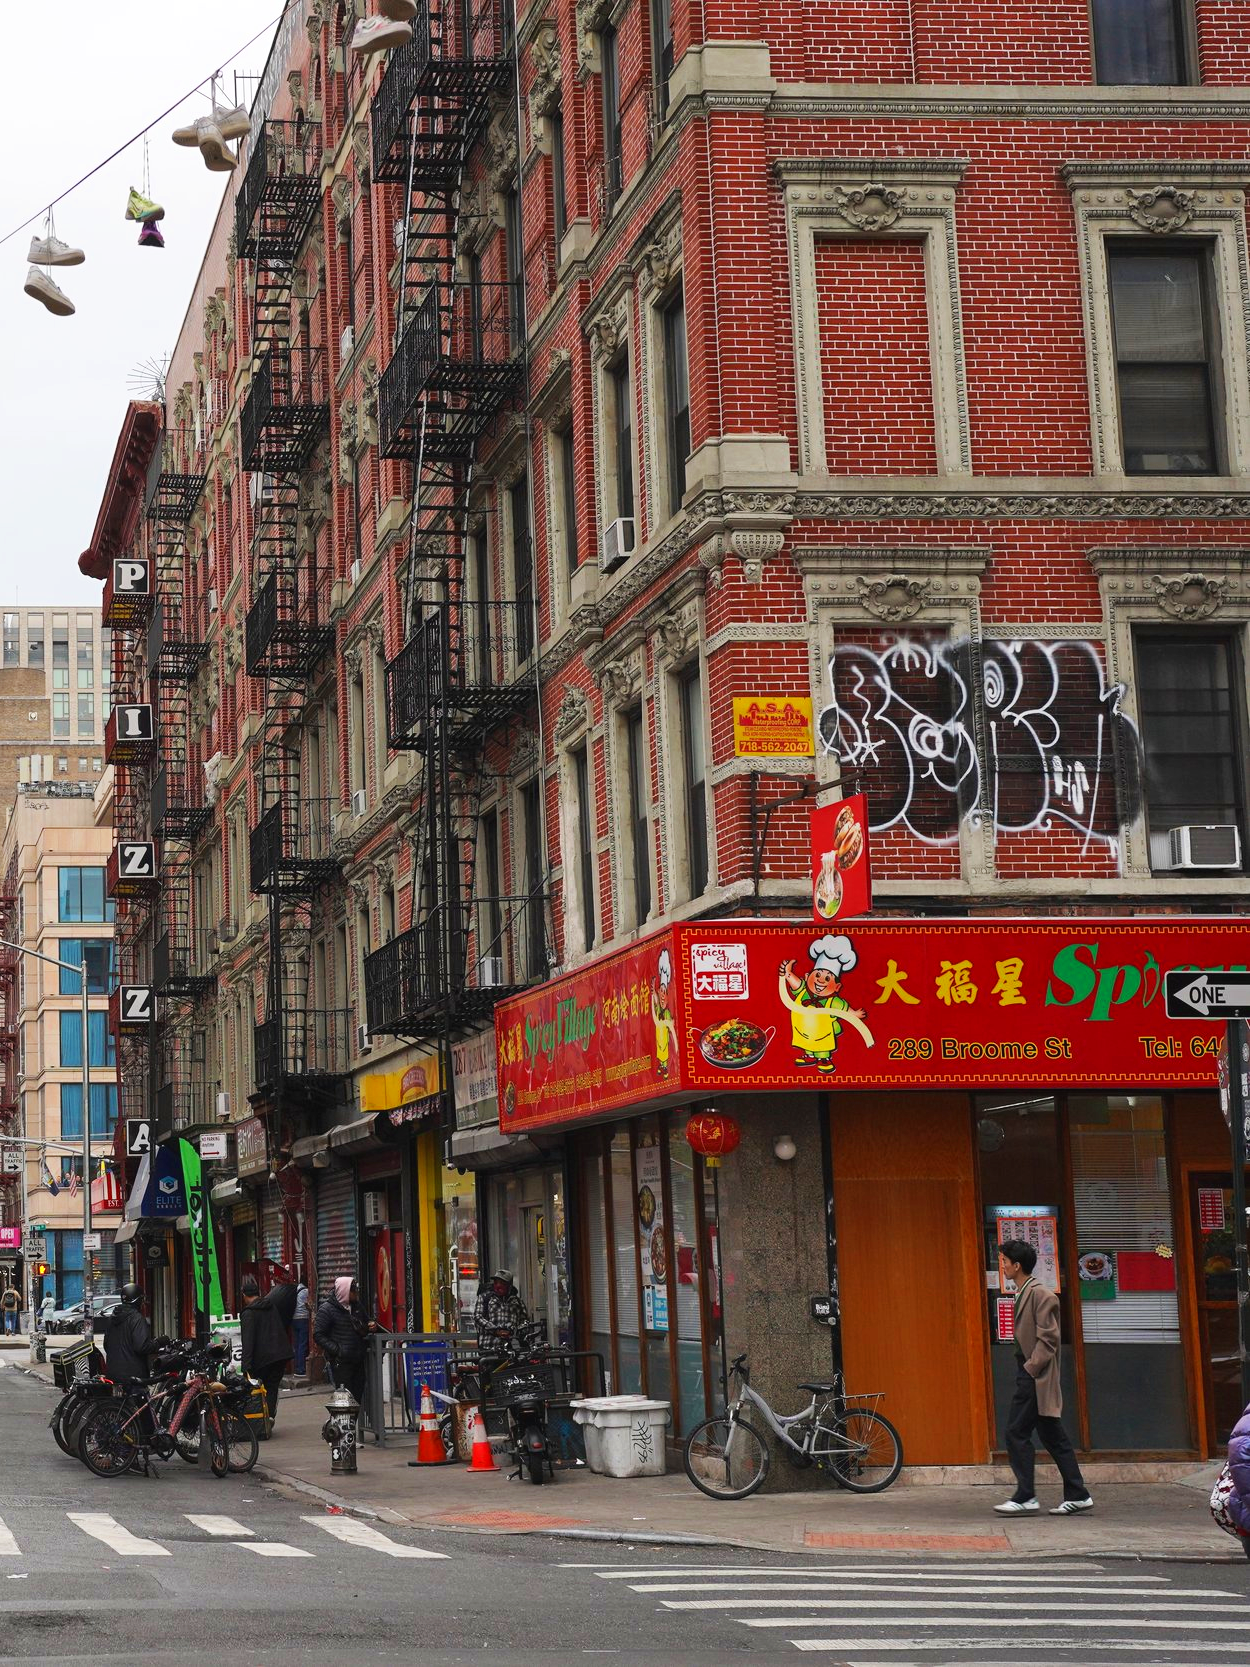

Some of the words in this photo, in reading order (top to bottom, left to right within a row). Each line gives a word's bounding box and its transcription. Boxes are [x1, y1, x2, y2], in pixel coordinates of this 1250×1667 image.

[740, 742, 808, 752] 718-562-2047
[695, 947, 726, 961] spicy
[697, 974, 744, 992] 大福星
[874, 957, 1027, 1006] 大福星
[1189, 986, 1226, 1004] ONE
[525, 1012, 556, 1068] Spicy
[557, 997, 598, 1051] Village
[888, 1037, 933, 1060] 289
[942, 1037, 1039, 1059] Broome
[1045, 1036, 1072, 1059] St
[1139, 1036, 1182, 1058] Tel:
[1190, 1036, 1224, 1058] 64
[156, 1196, 182, 1205] ELITE
[1, 1229, 14, 1239] OPEN
